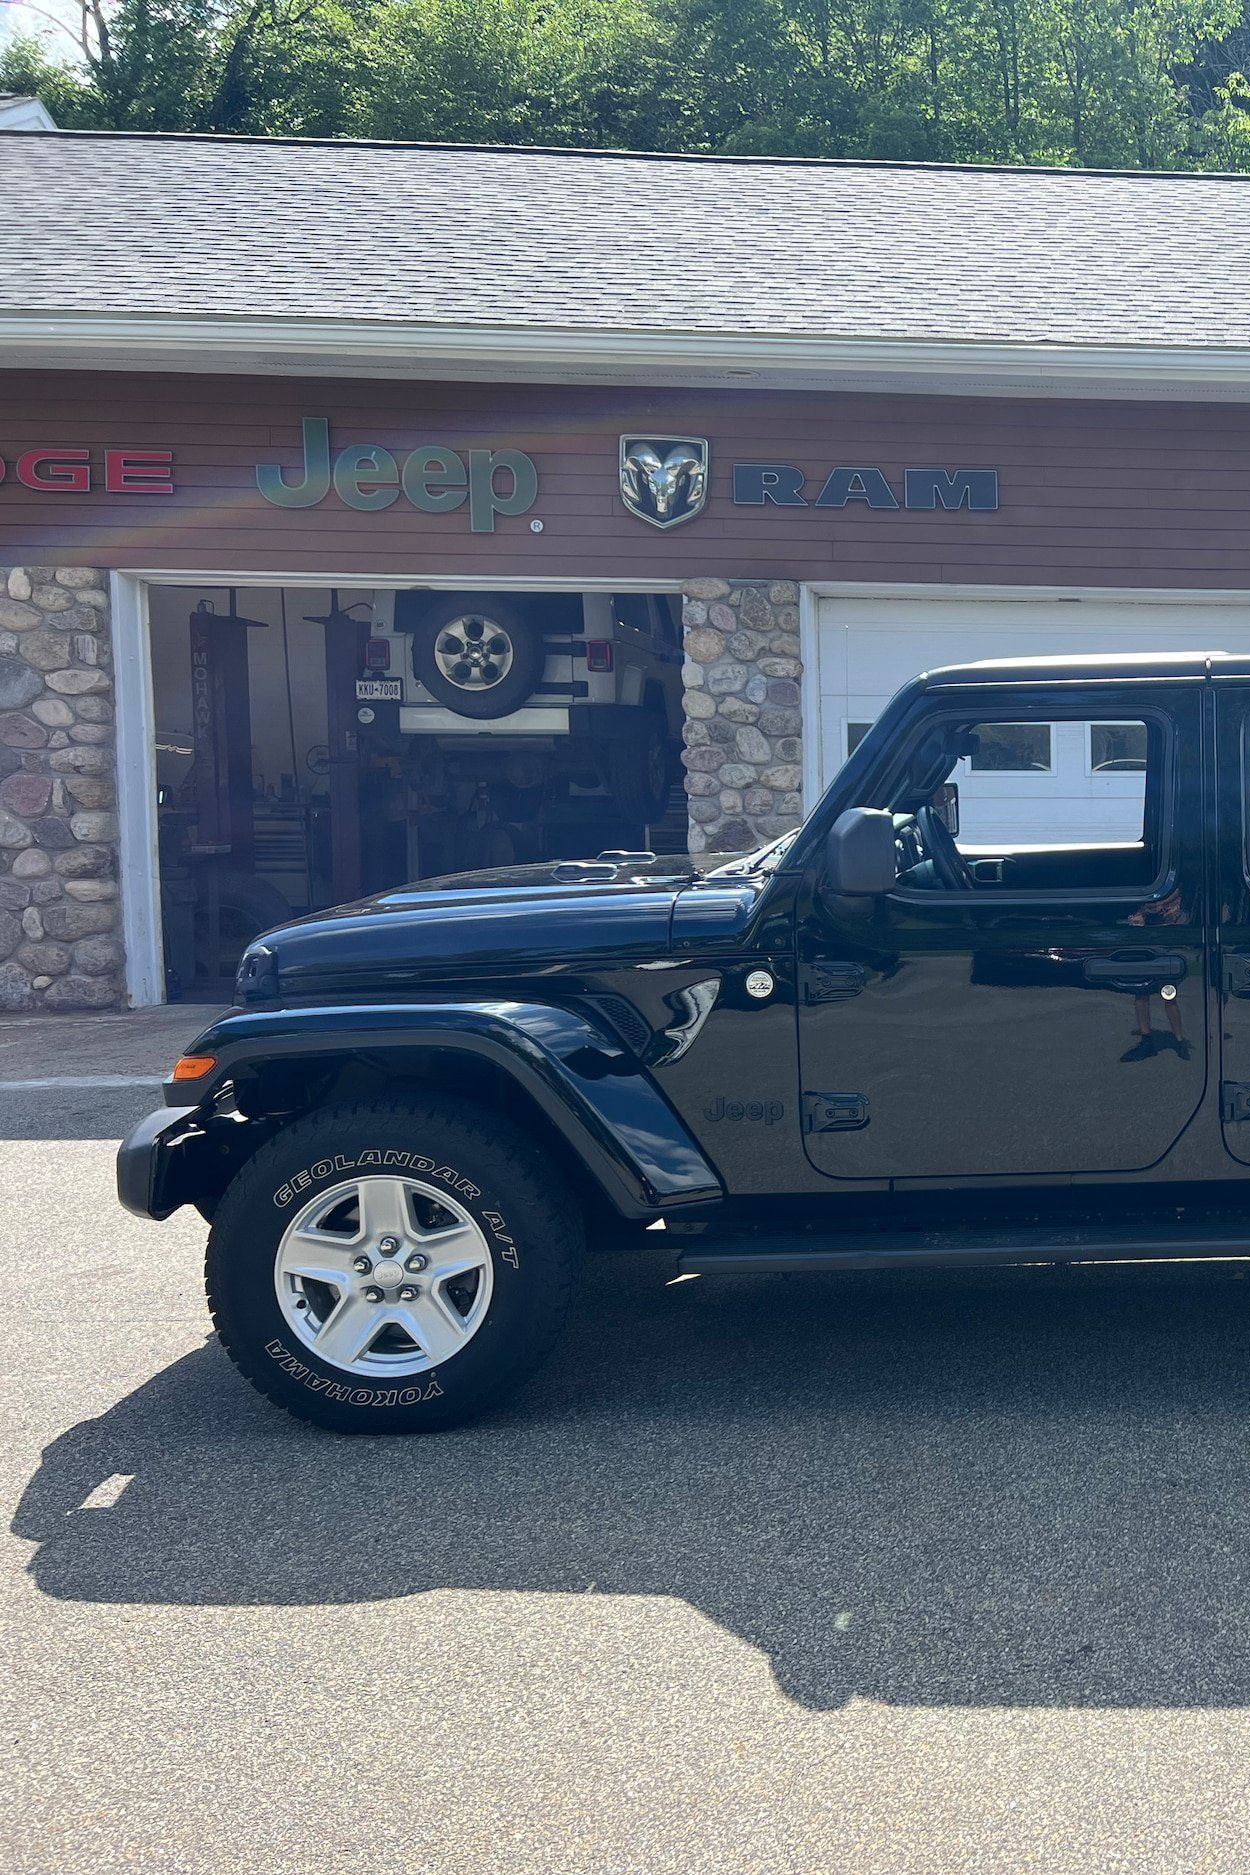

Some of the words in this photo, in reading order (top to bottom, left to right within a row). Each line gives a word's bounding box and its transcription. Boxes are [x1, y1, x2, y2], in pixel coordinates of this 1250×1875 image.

[0, 449, 174, 494] GE
[255, 417, 539, 533] Jeep
[733, 463, 1000, 510] RAM
[703, 1096, 785, 1126] Jeep
[273, 1150, 481, 1207] GEOLANDAR
[481, 1210, 519, 1269] A/T
[265, 1339, 444, 1406] YOKOHAMA
